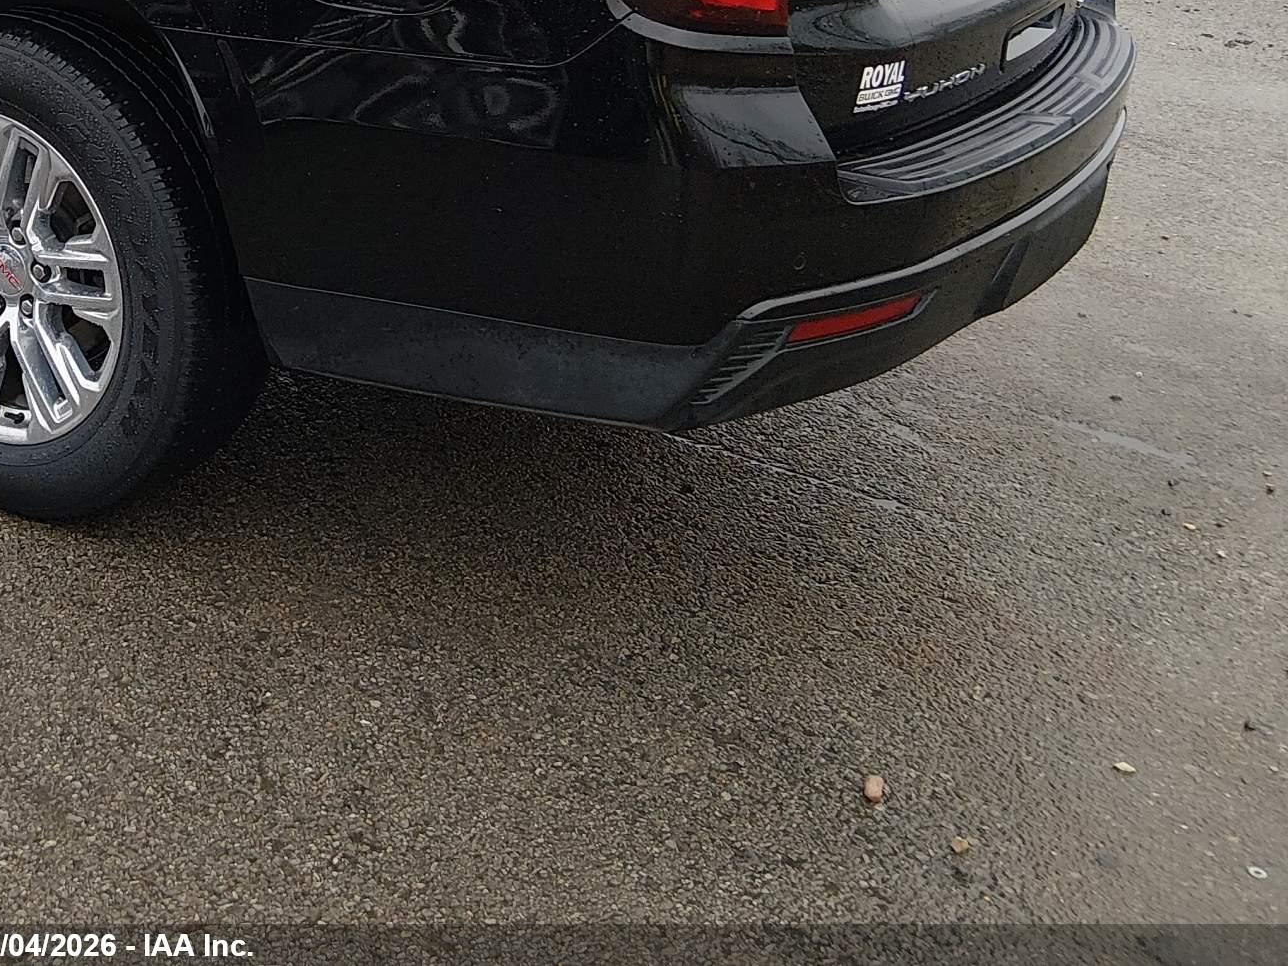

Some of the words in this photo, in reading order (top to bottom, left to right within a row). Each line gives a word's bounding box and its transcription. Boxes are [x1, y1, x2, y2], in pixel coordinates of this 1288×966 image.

[859, 60, 906, 90] ROYAL
[903, 63, 987, 103] YUKON
[858, 91, 884, 102] BUICK
